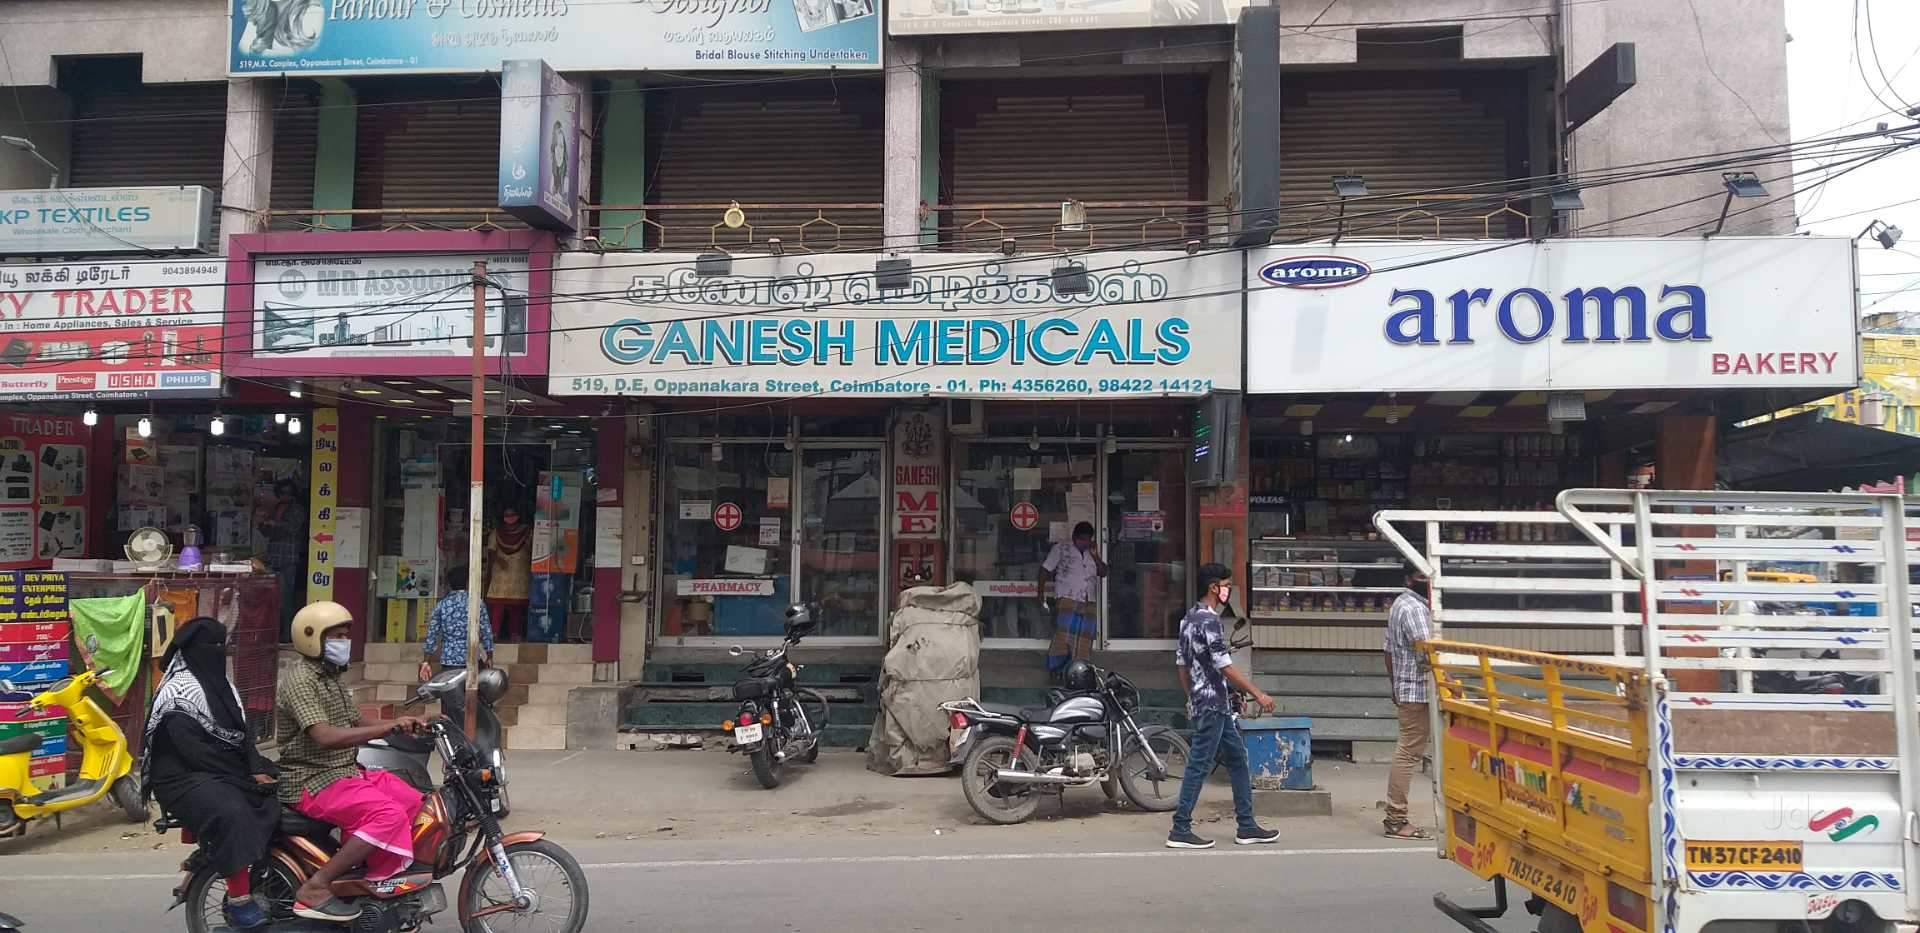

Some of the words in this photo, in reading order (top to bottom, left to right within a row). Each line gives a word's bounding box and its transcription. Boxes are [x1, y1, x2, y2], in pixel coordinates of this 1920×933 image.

[695, 50, 724, 60] Bridal
[727, 50, 760, 60] Blouse
[764, 50, 805, 61] Stitching
[809, 50, 868, 60] Undertaken
[37, 207, 150, 223] TEXTILES
[26, 267, 70, 283] லக்கி
[76, 265, 130, 285] டிரேடர்
[162, 266, 218, 275] 9043894948
[1271, 266, 1358, 278] aroma
[364, 267, 512, 297] ASSOCIAES
[52, 287, 194, 317] TRADER
[1383, 281, 1713, 346] aroma
[23, 320, 50, 329] Home
[54, 319, 111, 331] Appliances,
[115, 319, 141, 327] Sales
[155, 317, 193, 326] Service
[600, 318, 855, 366] GANESH
[875, 318, 1191, 366] MEDICALS
[1711, 352, 1839, 374] BAKERY
[110, 376, 155, 387] USHA
[166, 375, 207, 383] PHILIPS
[572, 379, 608, 394] 519,
[614, 379, 648, 394] D.E,
[654, 379, 759, 394] Oppanakara
[830, 379, 930, 393] Coimbatore
[947, 380, 972, 392] 01.
[979, 379, 1006, 392] Ph:
[1012, 379, 1092, 395] 4356260,
[1099, 379, 1153, 392] 98422
[1160, 379, 1213, 392] 14121
[11, 417, 75, 436] TRADER
[896, 465, 940, 486] GANESH
[692, 582, 762, 592] PHARMACY
